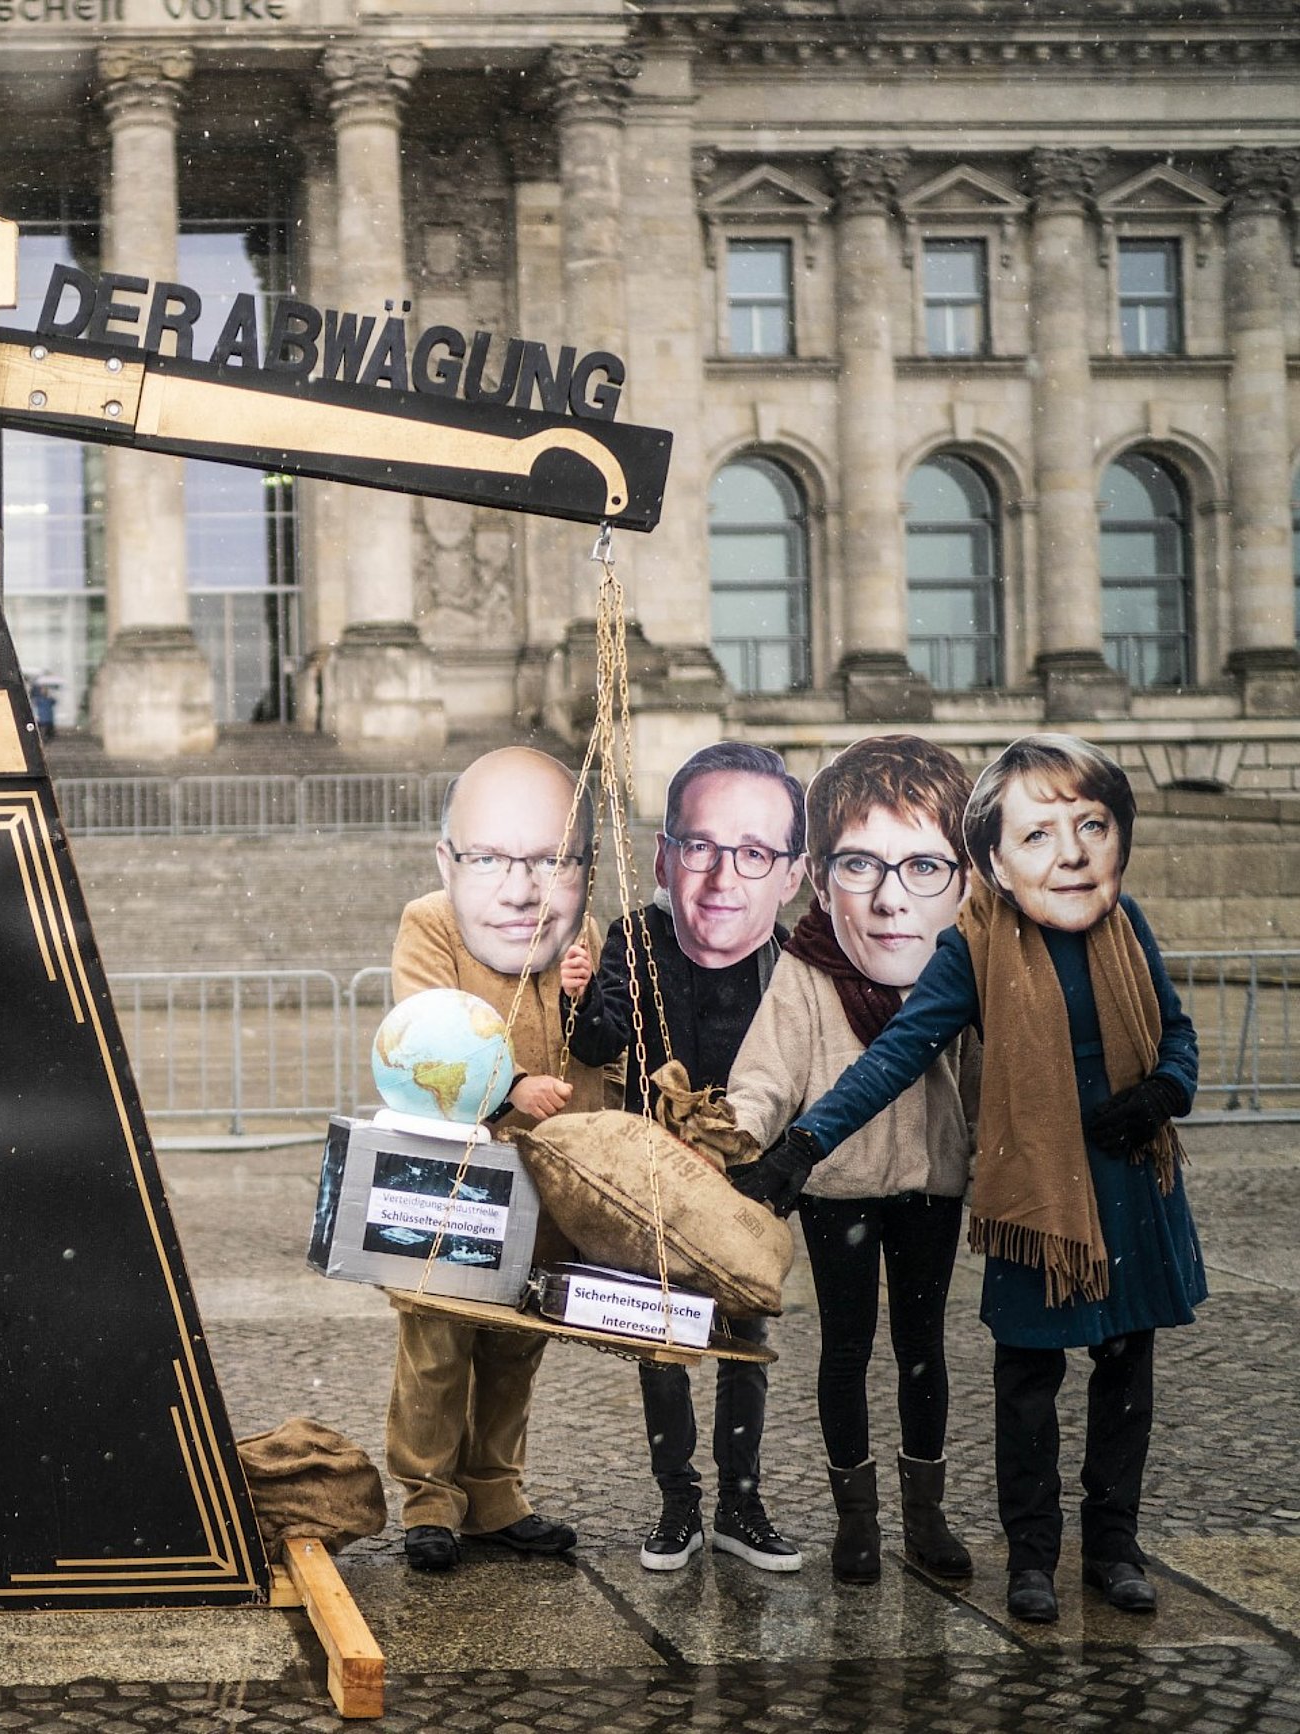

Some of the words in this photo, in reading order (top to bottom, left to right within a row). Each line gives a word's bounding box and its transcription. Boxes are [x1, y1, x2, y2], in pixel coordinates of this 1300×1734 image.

[37, 263, 201, 358] DER
[210, 292, 626, 422] ABWÄGUNG
[382, 1193, 499, 1217] Verteidigungsndustrielle
[574, 1286, 701, 1319] Sicherheitspoliische
[601, 1315, 667, 1336] Interessen
